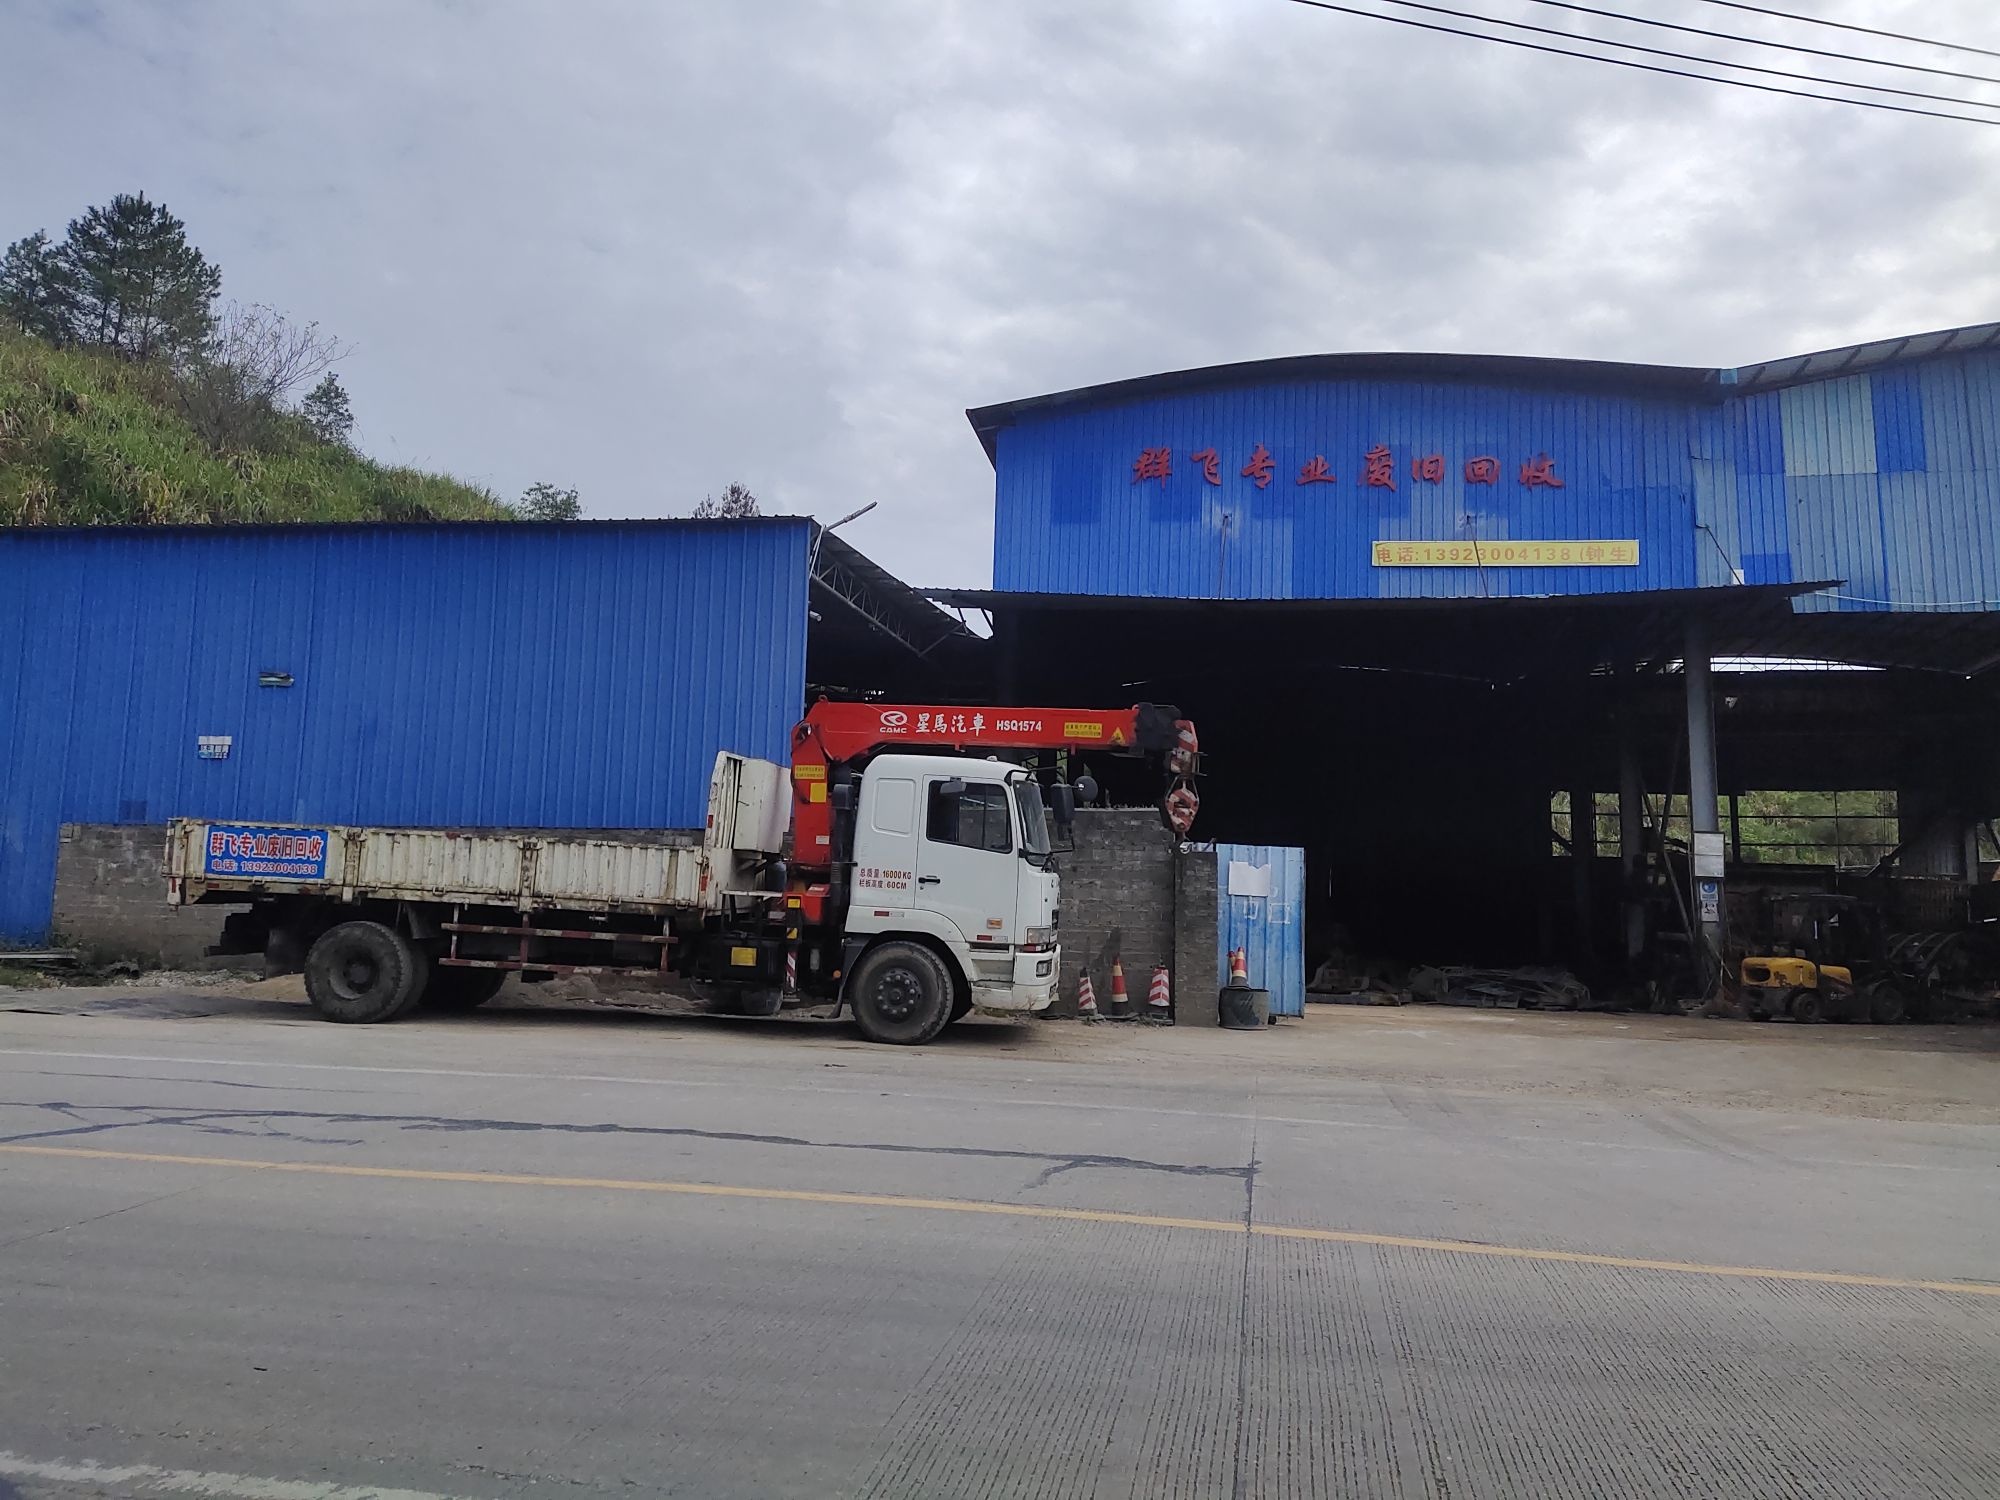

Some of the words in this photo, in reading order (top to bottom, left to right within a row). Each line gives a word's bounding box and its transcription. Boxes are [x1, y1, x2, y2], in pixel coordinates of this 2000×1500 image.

[1131, 444, 1565, 491] 群飞专业废旧回收
[915, 713, 986, 736] 星馬汽車
[996, 719, 1043, 732] HSQ1574
[210, 832, 323, 861] 群飞专业废旧回收
[241, 861, 318, 874] 13923004138
[883, 870, 902, 879] 16000
[902, 872, 912, 880] KG
[886, 881, 907, 890] 60CM
